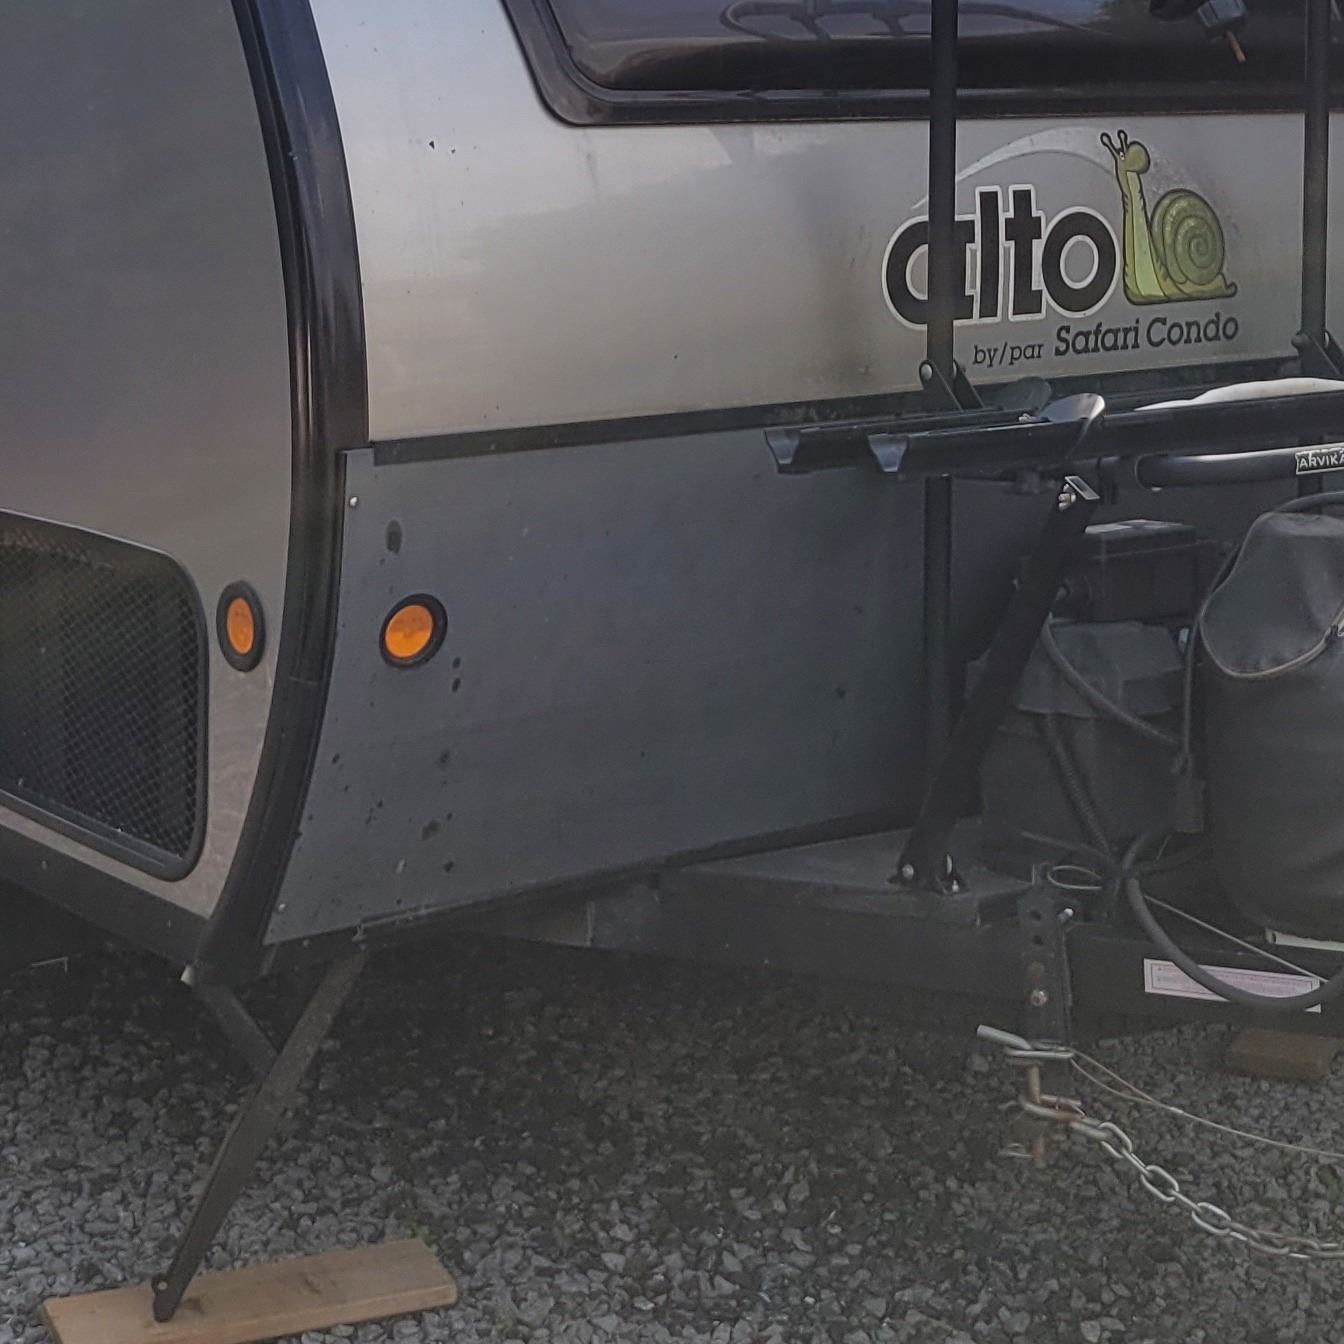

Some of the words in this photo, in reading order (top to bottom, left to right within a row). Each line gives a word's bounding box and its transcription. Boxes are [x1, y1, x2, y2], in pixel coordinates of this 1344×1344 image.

[882, 184, 1120, 330] alto
[972, 340, 1044, 368] by/par
[1054, 316, 1140, 357] Safari
[1146, 311, 1240, 348] Condo
